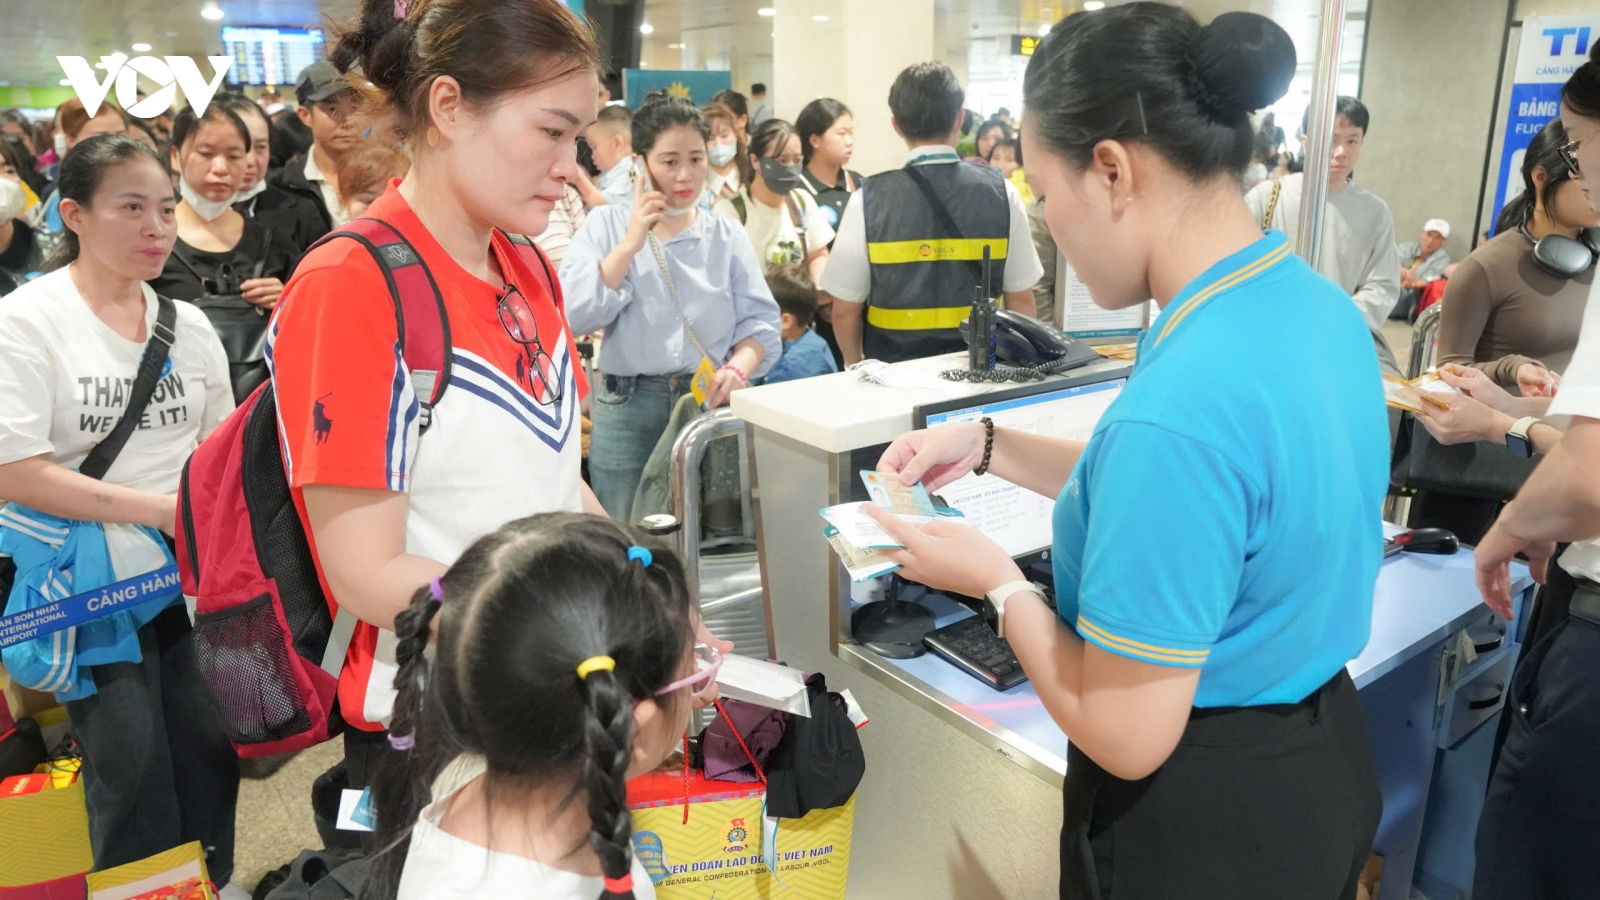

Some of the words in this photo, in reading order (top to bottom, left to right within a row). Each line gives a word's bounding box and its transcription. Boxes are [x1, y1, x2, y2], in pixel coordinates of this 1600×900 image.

[1518, 97, 1558, 117] BẢNG
[160, 405, 188, 426] IT!
[86, 589, 138, 612] CẢNG
[0, 617, 12, 629] AN
[14, 611, 35, 624] SON
[36, 602, 60, 617] NHAT
[0, 610, 68, 638] NTERNATIONAL
[726, 857, 747, 867] LAO
[809, 844, 833, 858] NAM
[665, 875, 702, 886] GENERAL
[703, 867, 767, 882] CONFEDERATION
[780, 862, 810, 872] LABOUR
